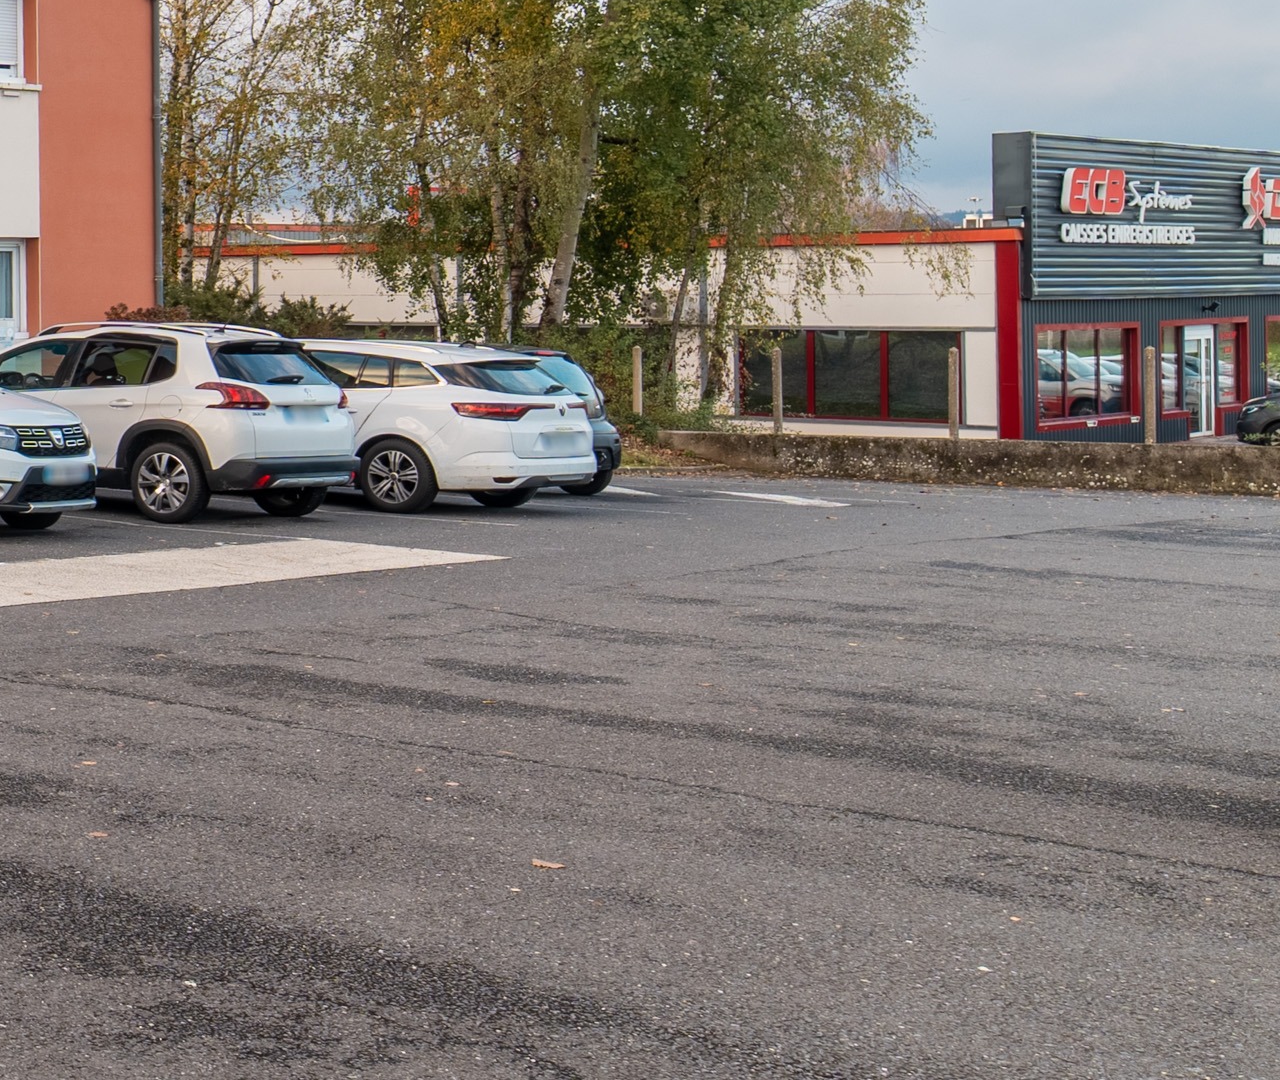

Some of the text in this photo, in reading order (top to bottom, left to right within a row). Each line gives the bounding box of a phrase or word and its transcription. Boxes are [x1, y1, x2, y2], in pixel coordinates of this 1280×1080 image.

[1061, 167, 1193, 224] ECB Systèmes
[1061, 223, 1196, 245] CAISSES ENREGISTREUSES
